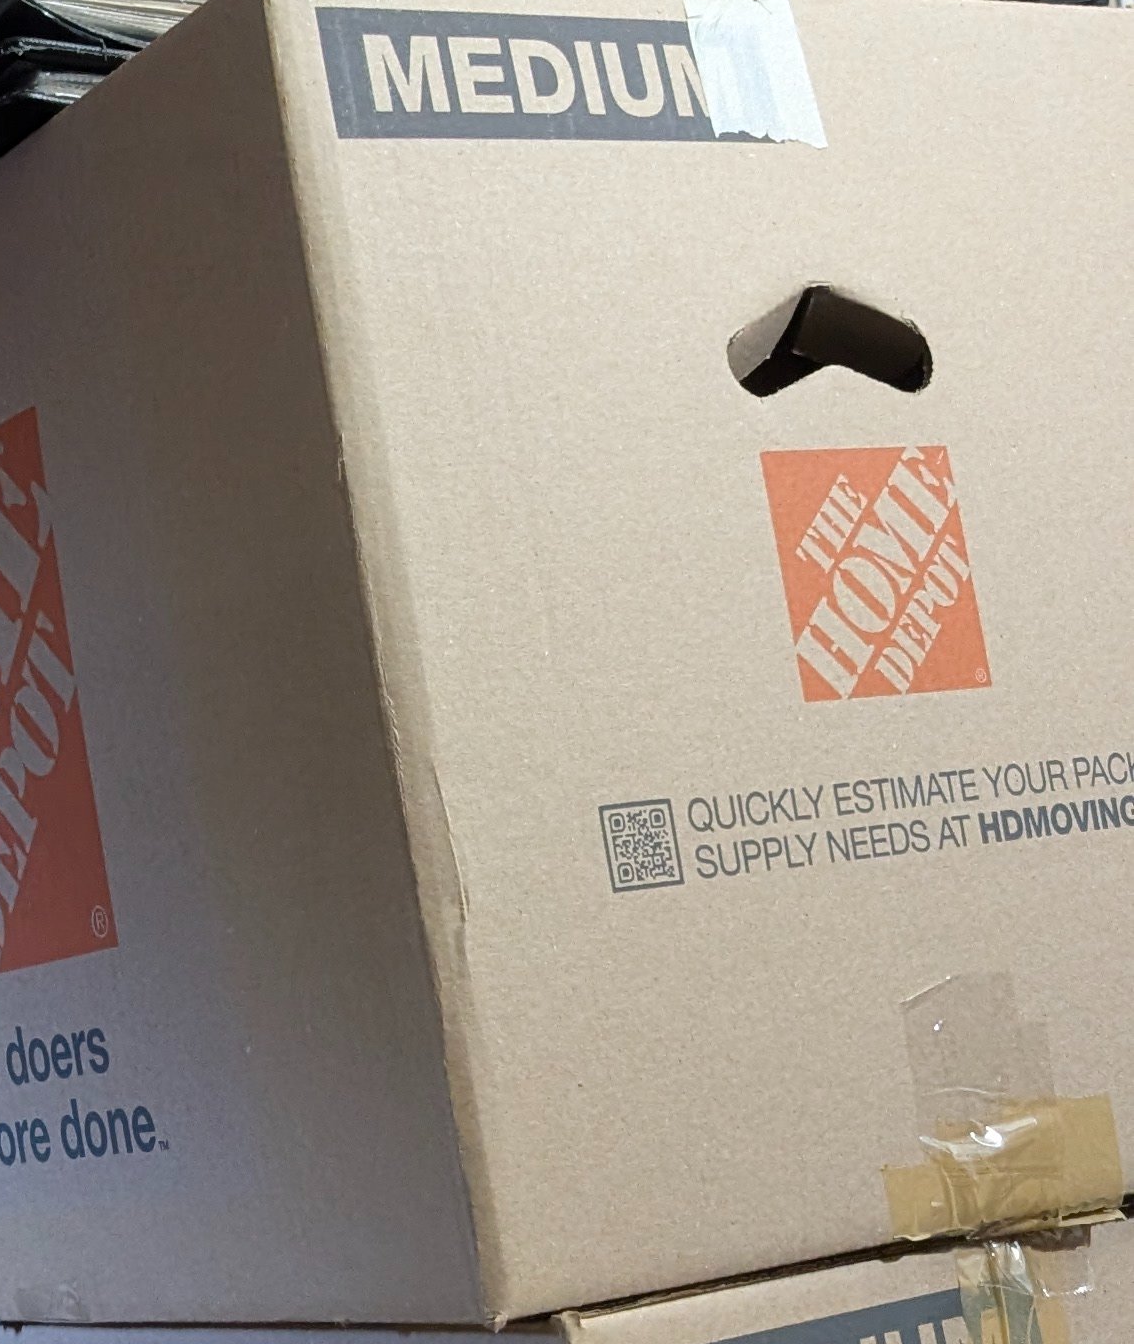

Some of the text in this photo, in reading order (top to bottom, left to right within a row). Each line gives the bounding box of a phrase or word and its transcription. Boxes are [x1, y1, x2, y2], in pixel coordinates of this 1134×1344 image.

[795, 472, 868, 574] THE
[794, 446, 958, 699] HOME
[873, 532, 972, 695] DEPOT
[687, 785, 824, 832] QUICKLY
[833, 769, 976, 816] ESTIMATE
[982, 759, 1068, 799] YOUR
[695, 832, 818, 879] SUPPLY
[827, 822, 931, 864] NEEDS
[938, 815, 972, 851] AT
[5, 1025, 110, 1086] doers
[59, 1100, 157, 1161] done.
